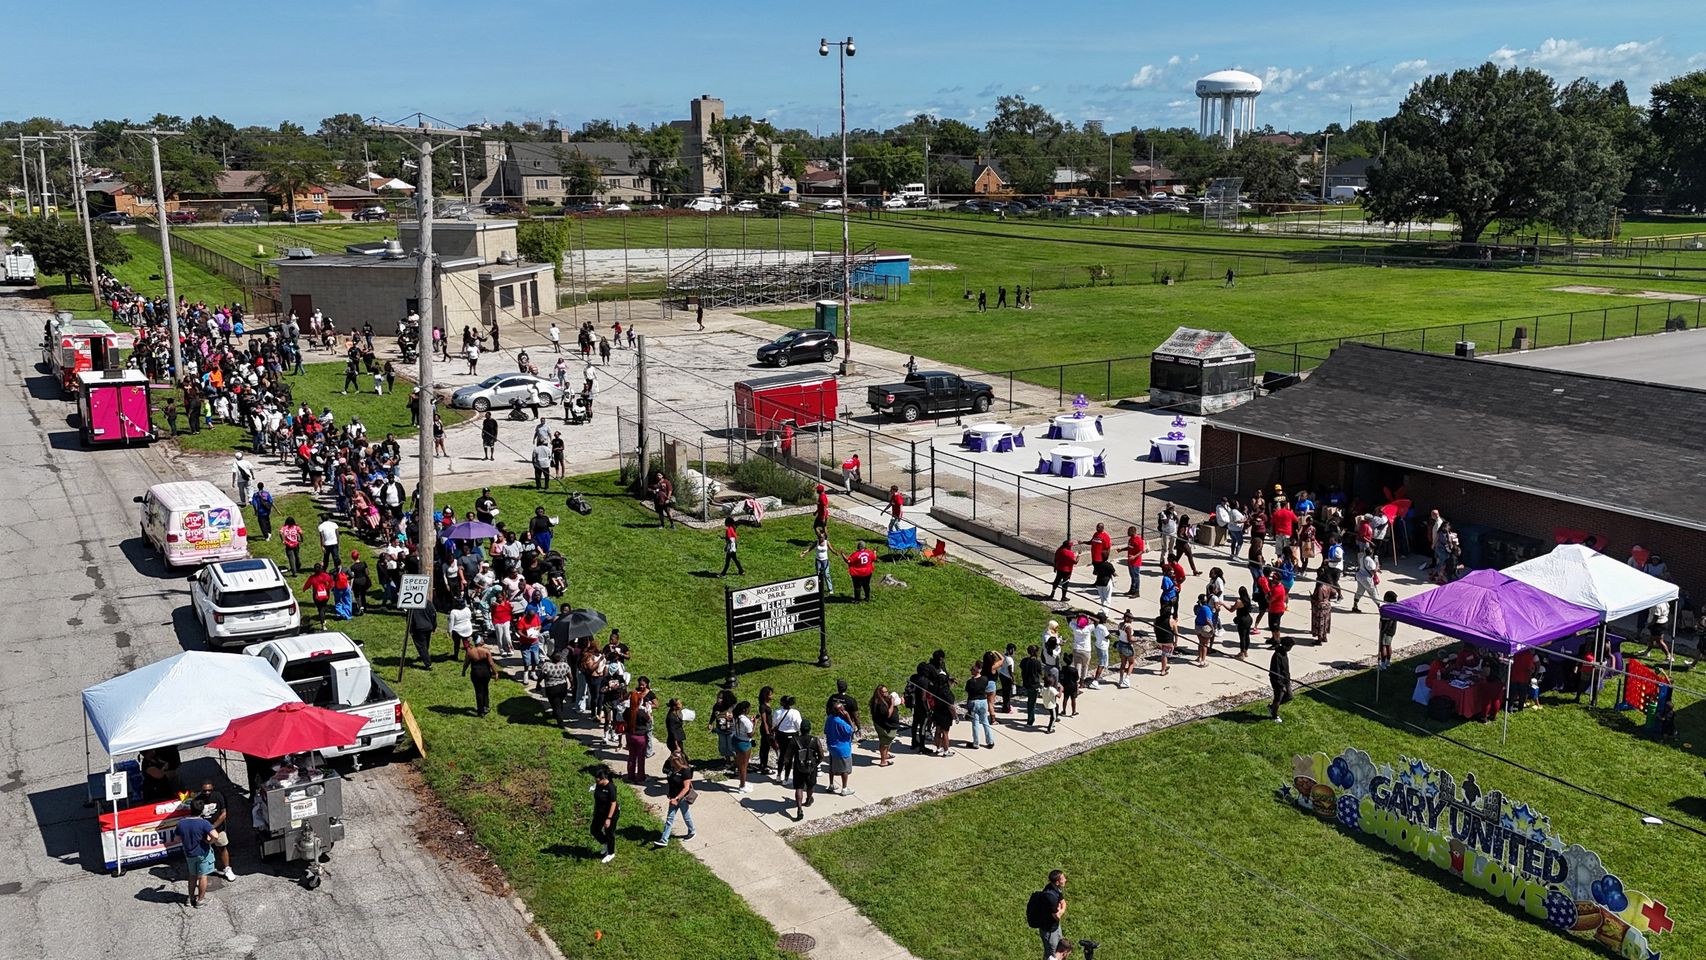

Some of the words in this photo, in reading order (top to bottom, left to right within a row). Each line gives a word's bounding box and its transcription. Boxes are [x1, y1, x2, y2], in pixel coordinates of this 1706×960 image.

[756, 582, 796, 595] ROOSEVELT
[767, 591, 786, 599] PARK
[402, 592, 424, 604] 20
[761, 597, 795, 611] WELCOME
[770, 608, 787, 618] KIDS
[755, 613, 800, 630] ENRICHMENT
[761, 624, 794, 638] PROGRAM
[1368, 775, 1448, 831] GARY
[1450, 806, 1569, 884] UNITED
[1358, 794, 1451, 870] SHOWS
[1463, 849, 1549, 920] LOVE
